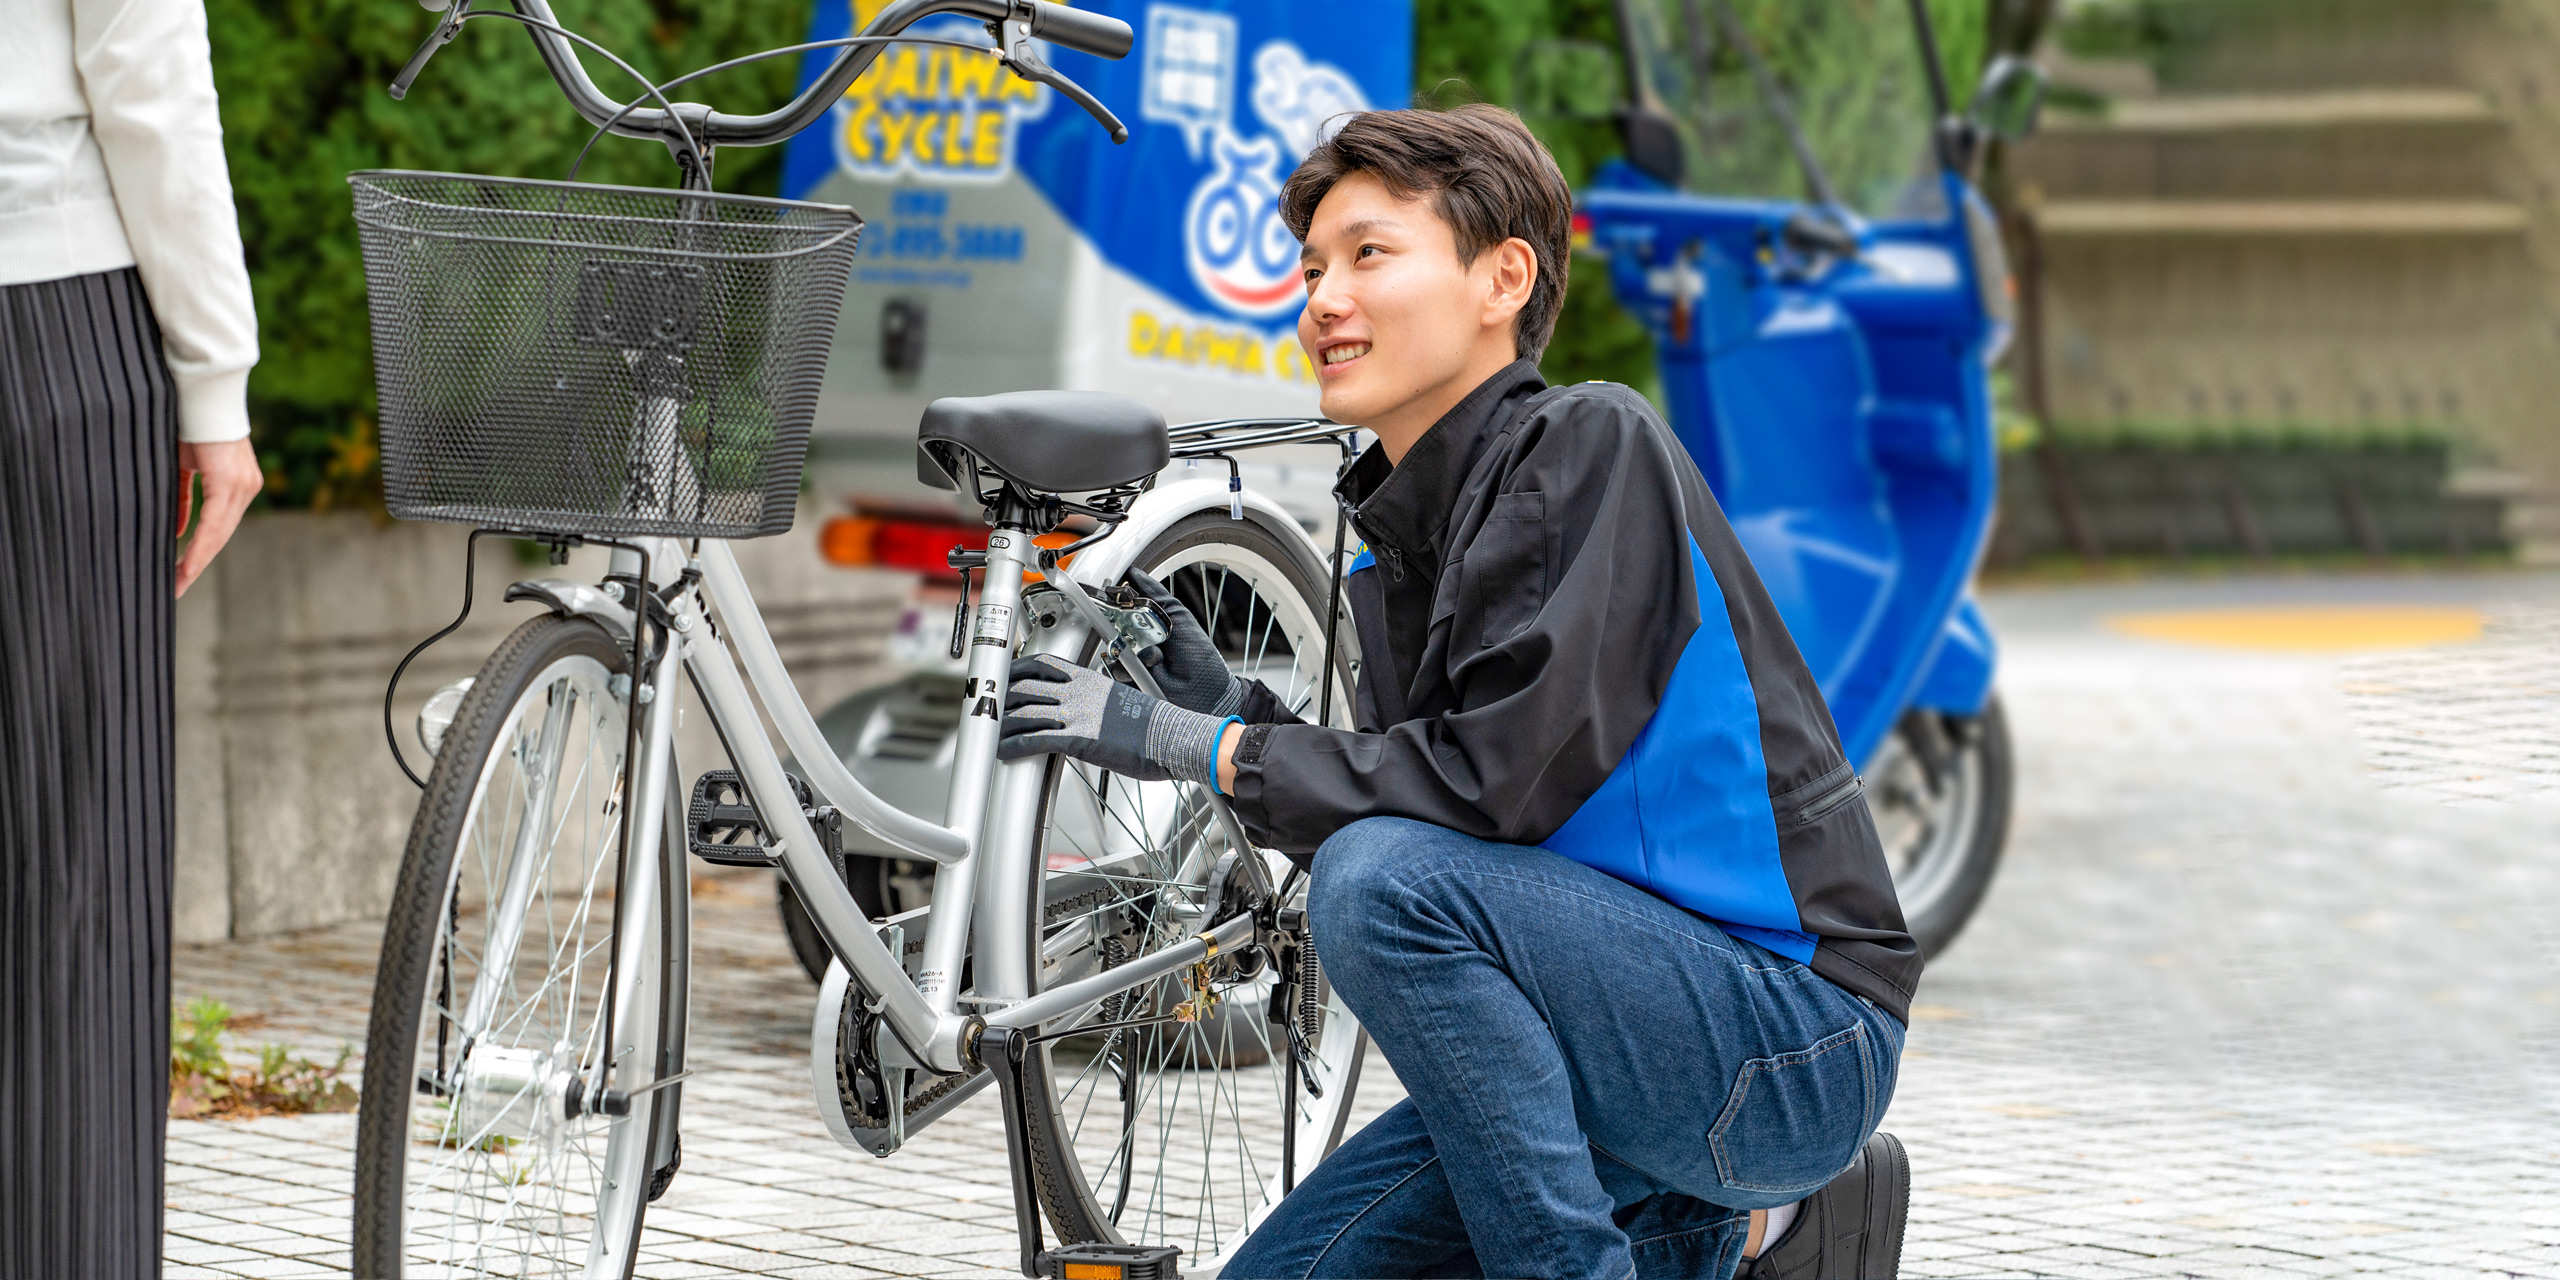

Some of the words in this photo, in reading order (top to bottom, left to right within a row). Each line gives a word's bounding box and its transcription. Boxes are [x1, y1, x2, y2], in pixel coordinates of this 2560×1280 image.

[846, 103, 1003, 166] CYCLE
[1130, 310, 1265, 377] DAIWA
[993, 538, 1005, 548] 26
